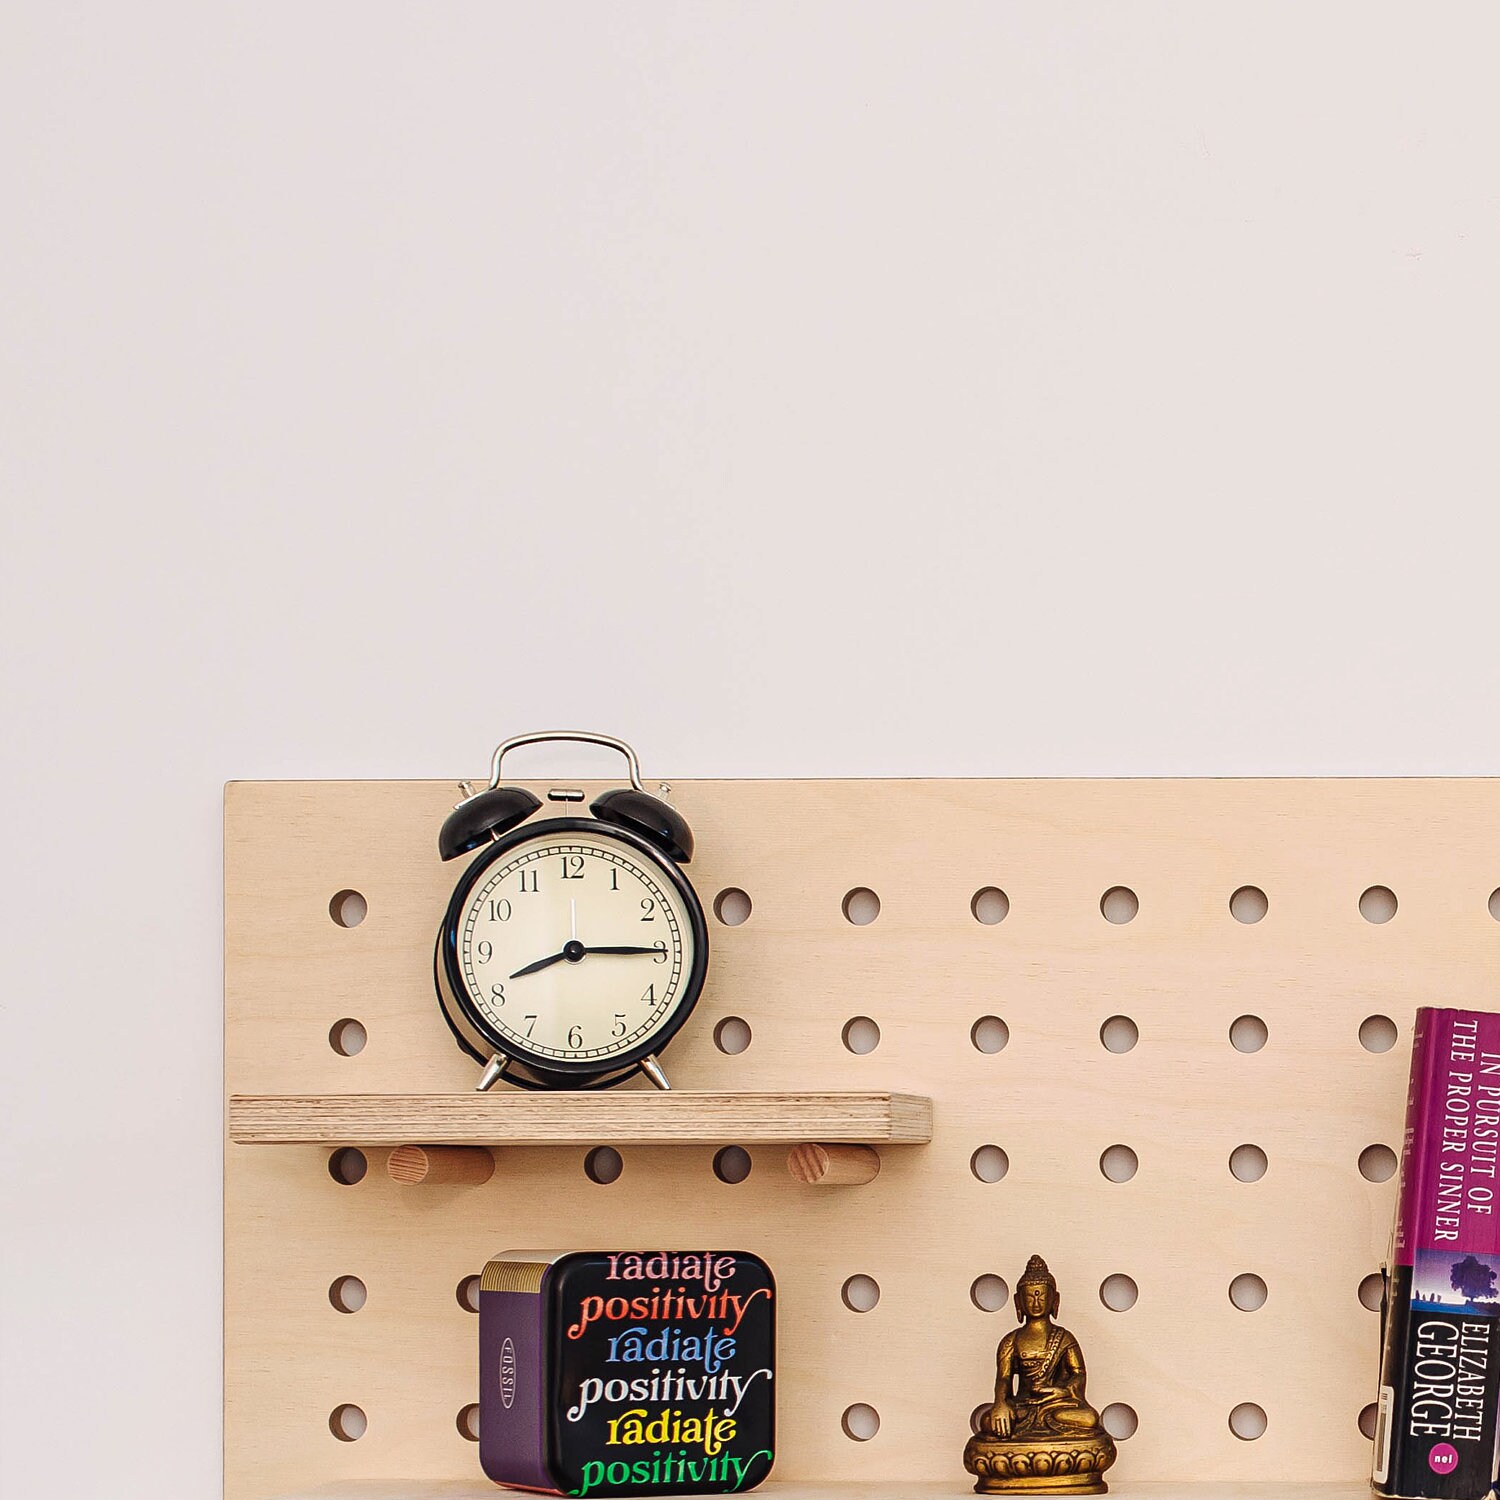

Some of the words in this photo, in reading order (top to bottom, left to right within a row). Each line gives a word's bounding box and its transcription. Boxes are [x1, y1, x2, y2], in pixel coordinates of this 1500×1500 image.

[561, 857, 585, 879] 12
[609, 867, 619, 891] 1
[519, 869, 540, 892] 11
[488, 899, 511, 922] 10
[640, 898, 655, 922] 2
[478, 941, 493, 964] 9
[653, 940, 668, 964] 3
[491, 983, 506, 1006] 8
[640, 983, 657, 1006] 4
[524, 1015, 537, 1038] 7
[567, 1025, 583, 1049] 6
[612, 1014, 627, 1037] 5
[1450, 1020, 1478, 1062] THE
[1443, 1071, 1473, 1153] PROPER
[1434, 1162, 1465, 1241] SINNER
[1467, 1187, 1494, 1215] OF
[606, 1251, 736, 1292] radiate
[567, 1287, 772, 1340] positivity
[605, 1326, 736, 1374] radiate
[1409, 1321, 1459, 1437] GEORGE
[1452, 1321, 1490, 1442] ELIZABETH
[567, 1368, 772, 1422] positivity
[606, 1408, 737, 1455] radiate
[1434, 1453, 1453, 1464] nel
[566, 1449, 772, 1497] positivity
